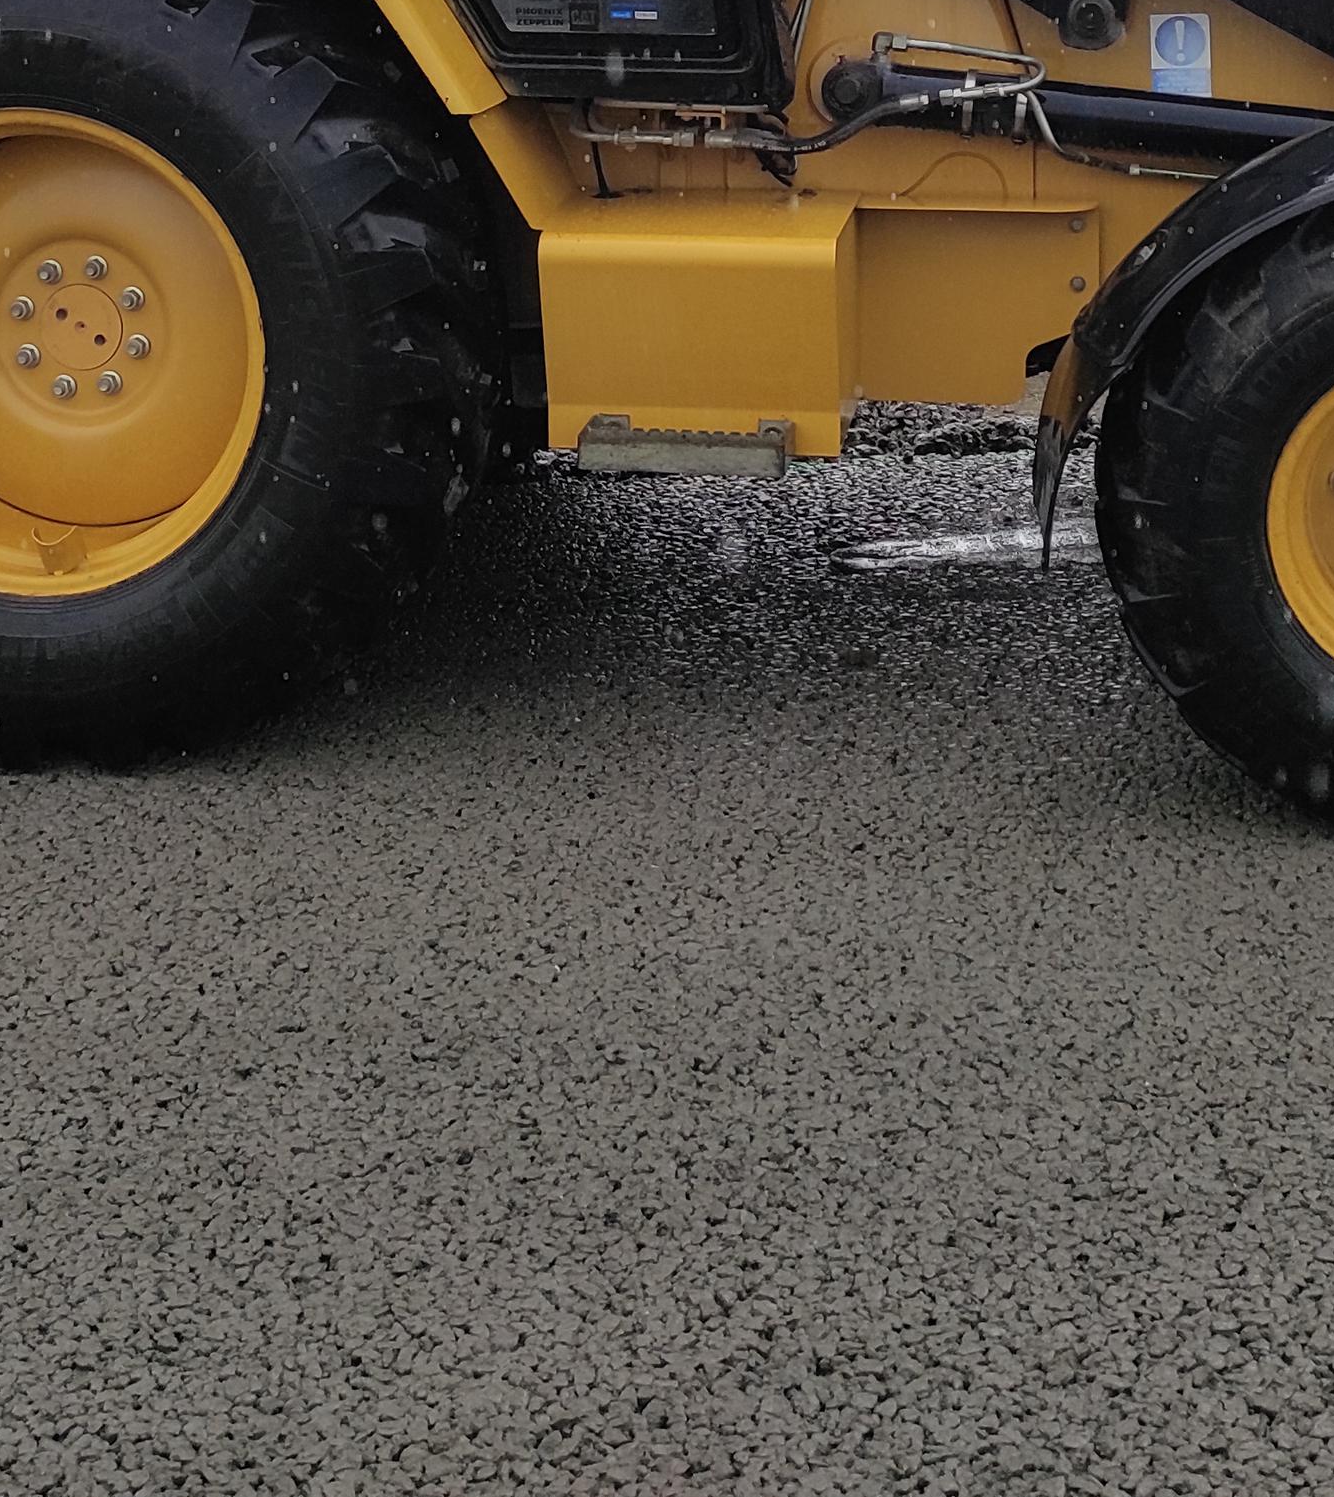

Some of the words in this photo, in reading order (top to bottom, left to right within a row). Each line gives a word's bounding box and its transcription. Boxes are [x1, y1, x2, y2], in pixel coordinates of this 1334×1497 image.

[516, 7, 563, 15] PHOENIX
[570, 8, 597, 25] CAT
[517, 18, 564, 26] ZEPPELIN
